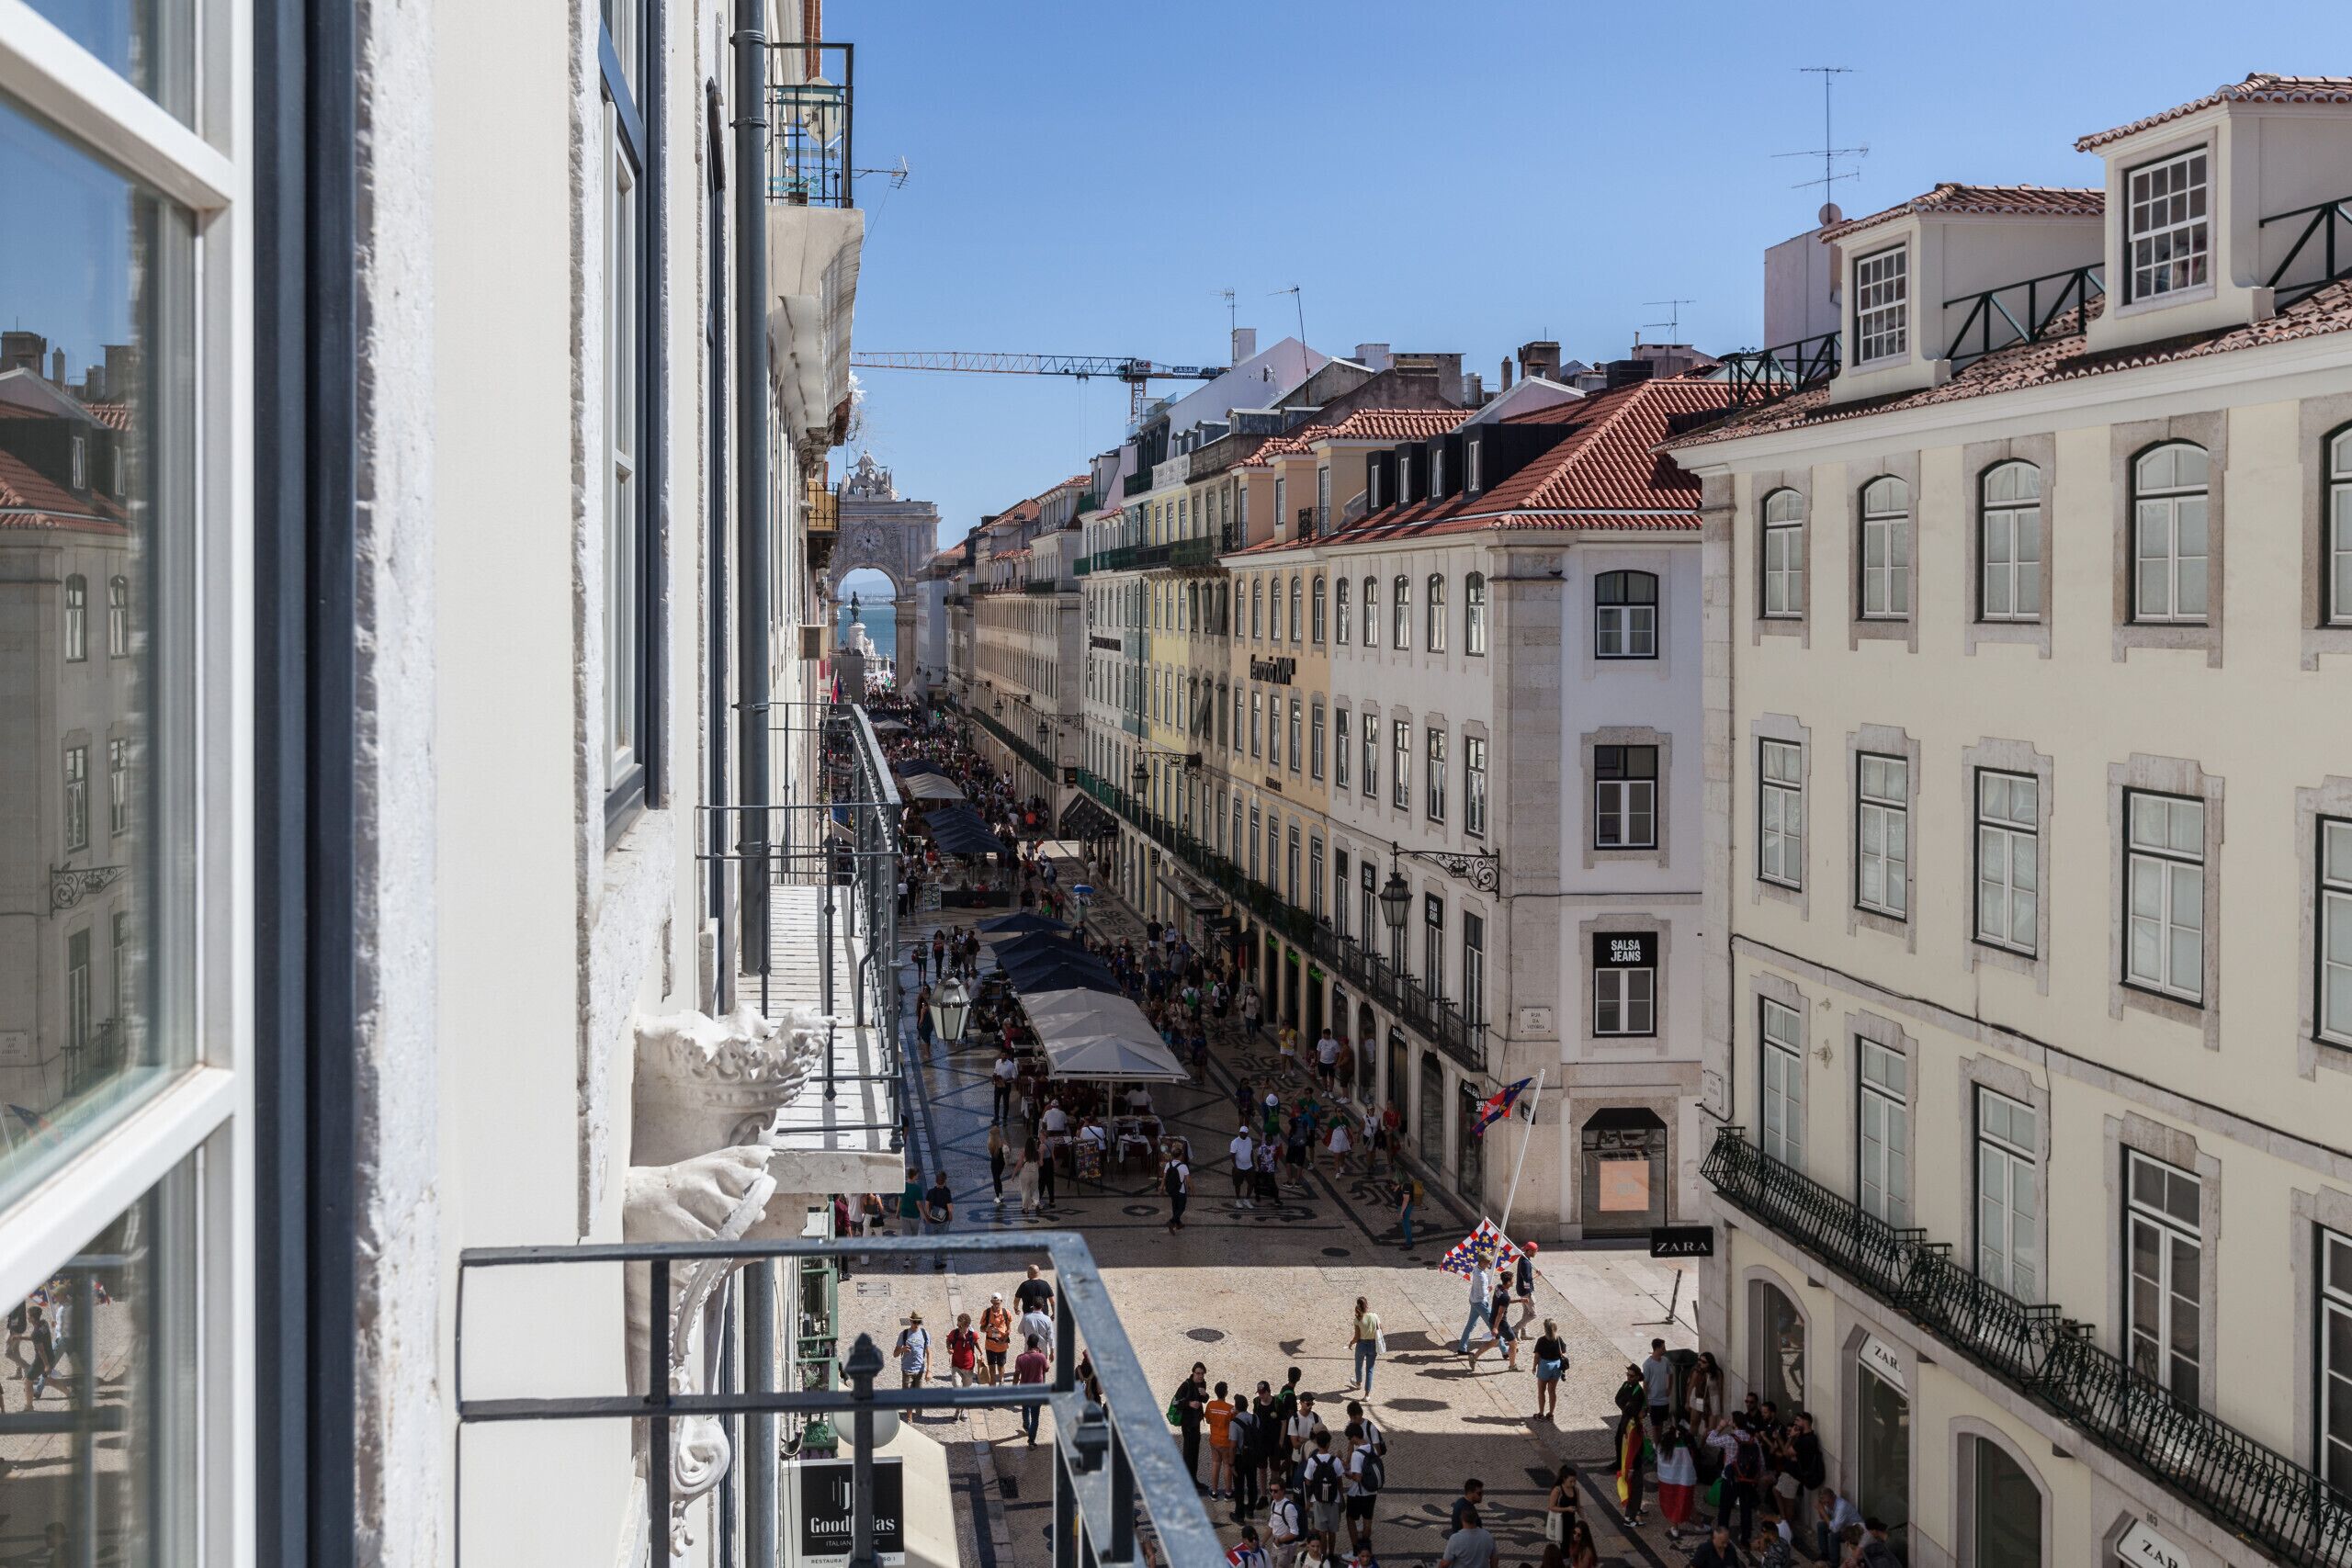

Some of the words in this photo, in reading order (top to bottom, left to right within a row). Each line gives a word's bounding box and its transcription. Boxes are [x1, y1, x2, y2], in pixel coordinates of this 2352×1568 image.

[1611, 940, 1641, 951] SALSA
[1611, 951, 1641, 962] JEANS
[1657, 1241, 1708, 1252] ZARA
[1874, 1345, 1903, 1373] ZAR
[810, 1515, 896, 1536] Goodlas
